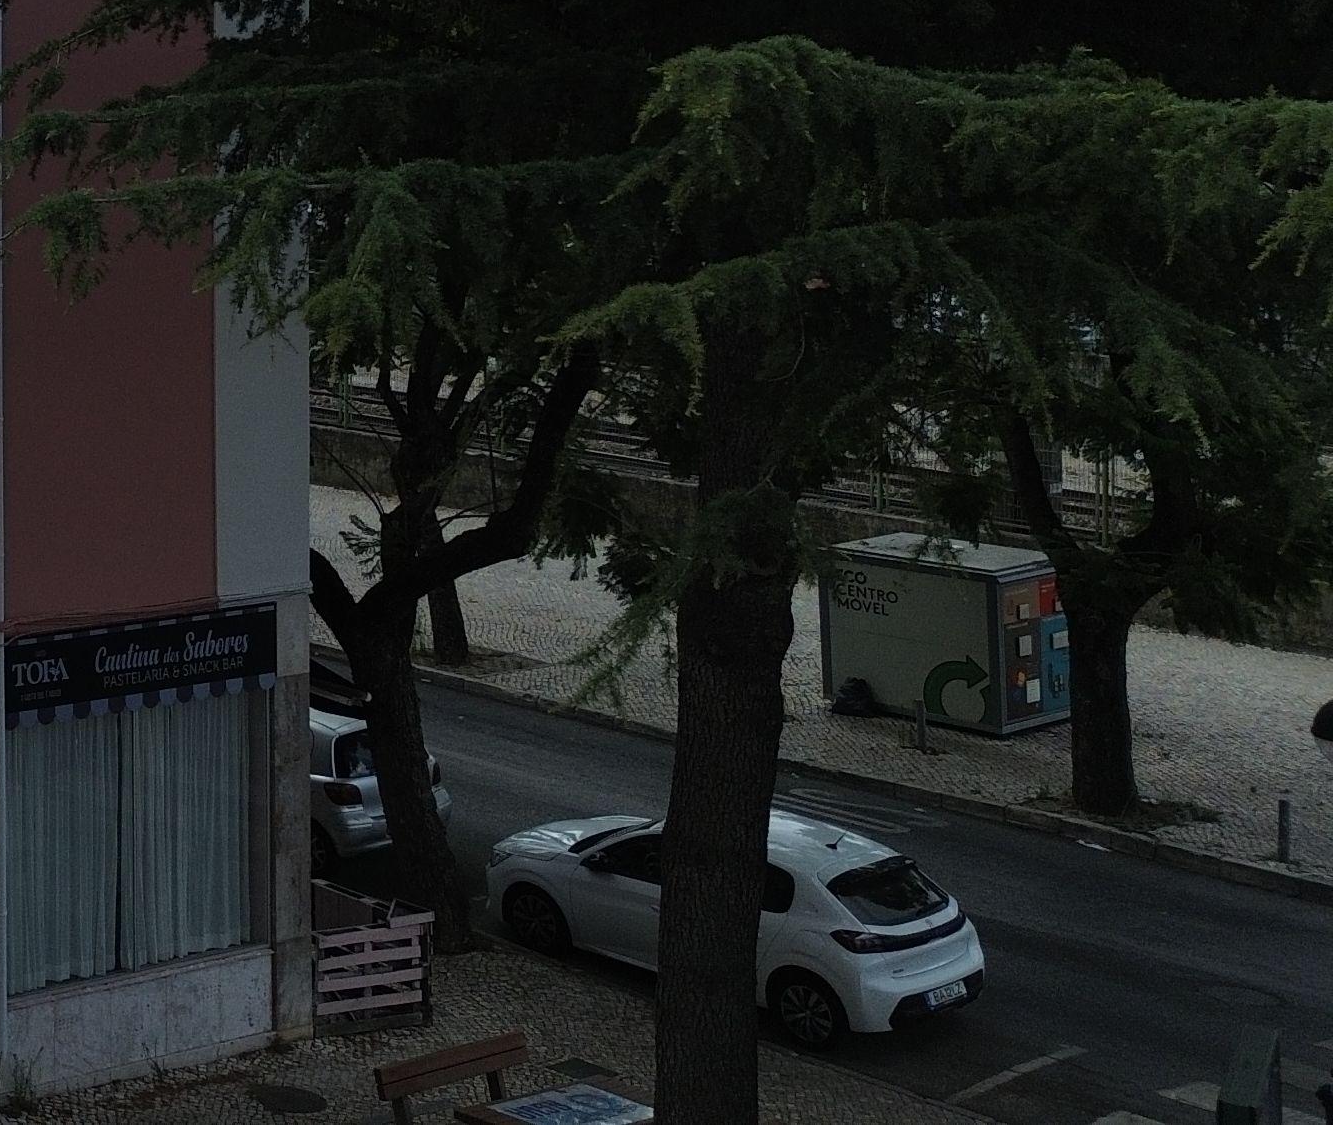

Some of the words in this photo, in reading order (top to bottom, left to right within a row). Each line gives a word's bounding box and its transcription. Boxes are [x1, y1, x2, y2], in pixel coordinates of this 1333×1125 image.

[835, 583, 899, 604] CENTRO
[95, 643, 160, 674] Cantina
[163, 646, 181, 664] dos
[182, 629, 249, 662] Sabores
[11, 658, 70, 687] TOFA
[103, 667, 170, 689] PASTELARIA
[172, 665, 180, 678] &
[182, 660, 220, 677] SNACK
[222, 656, 244, 671] BAR
